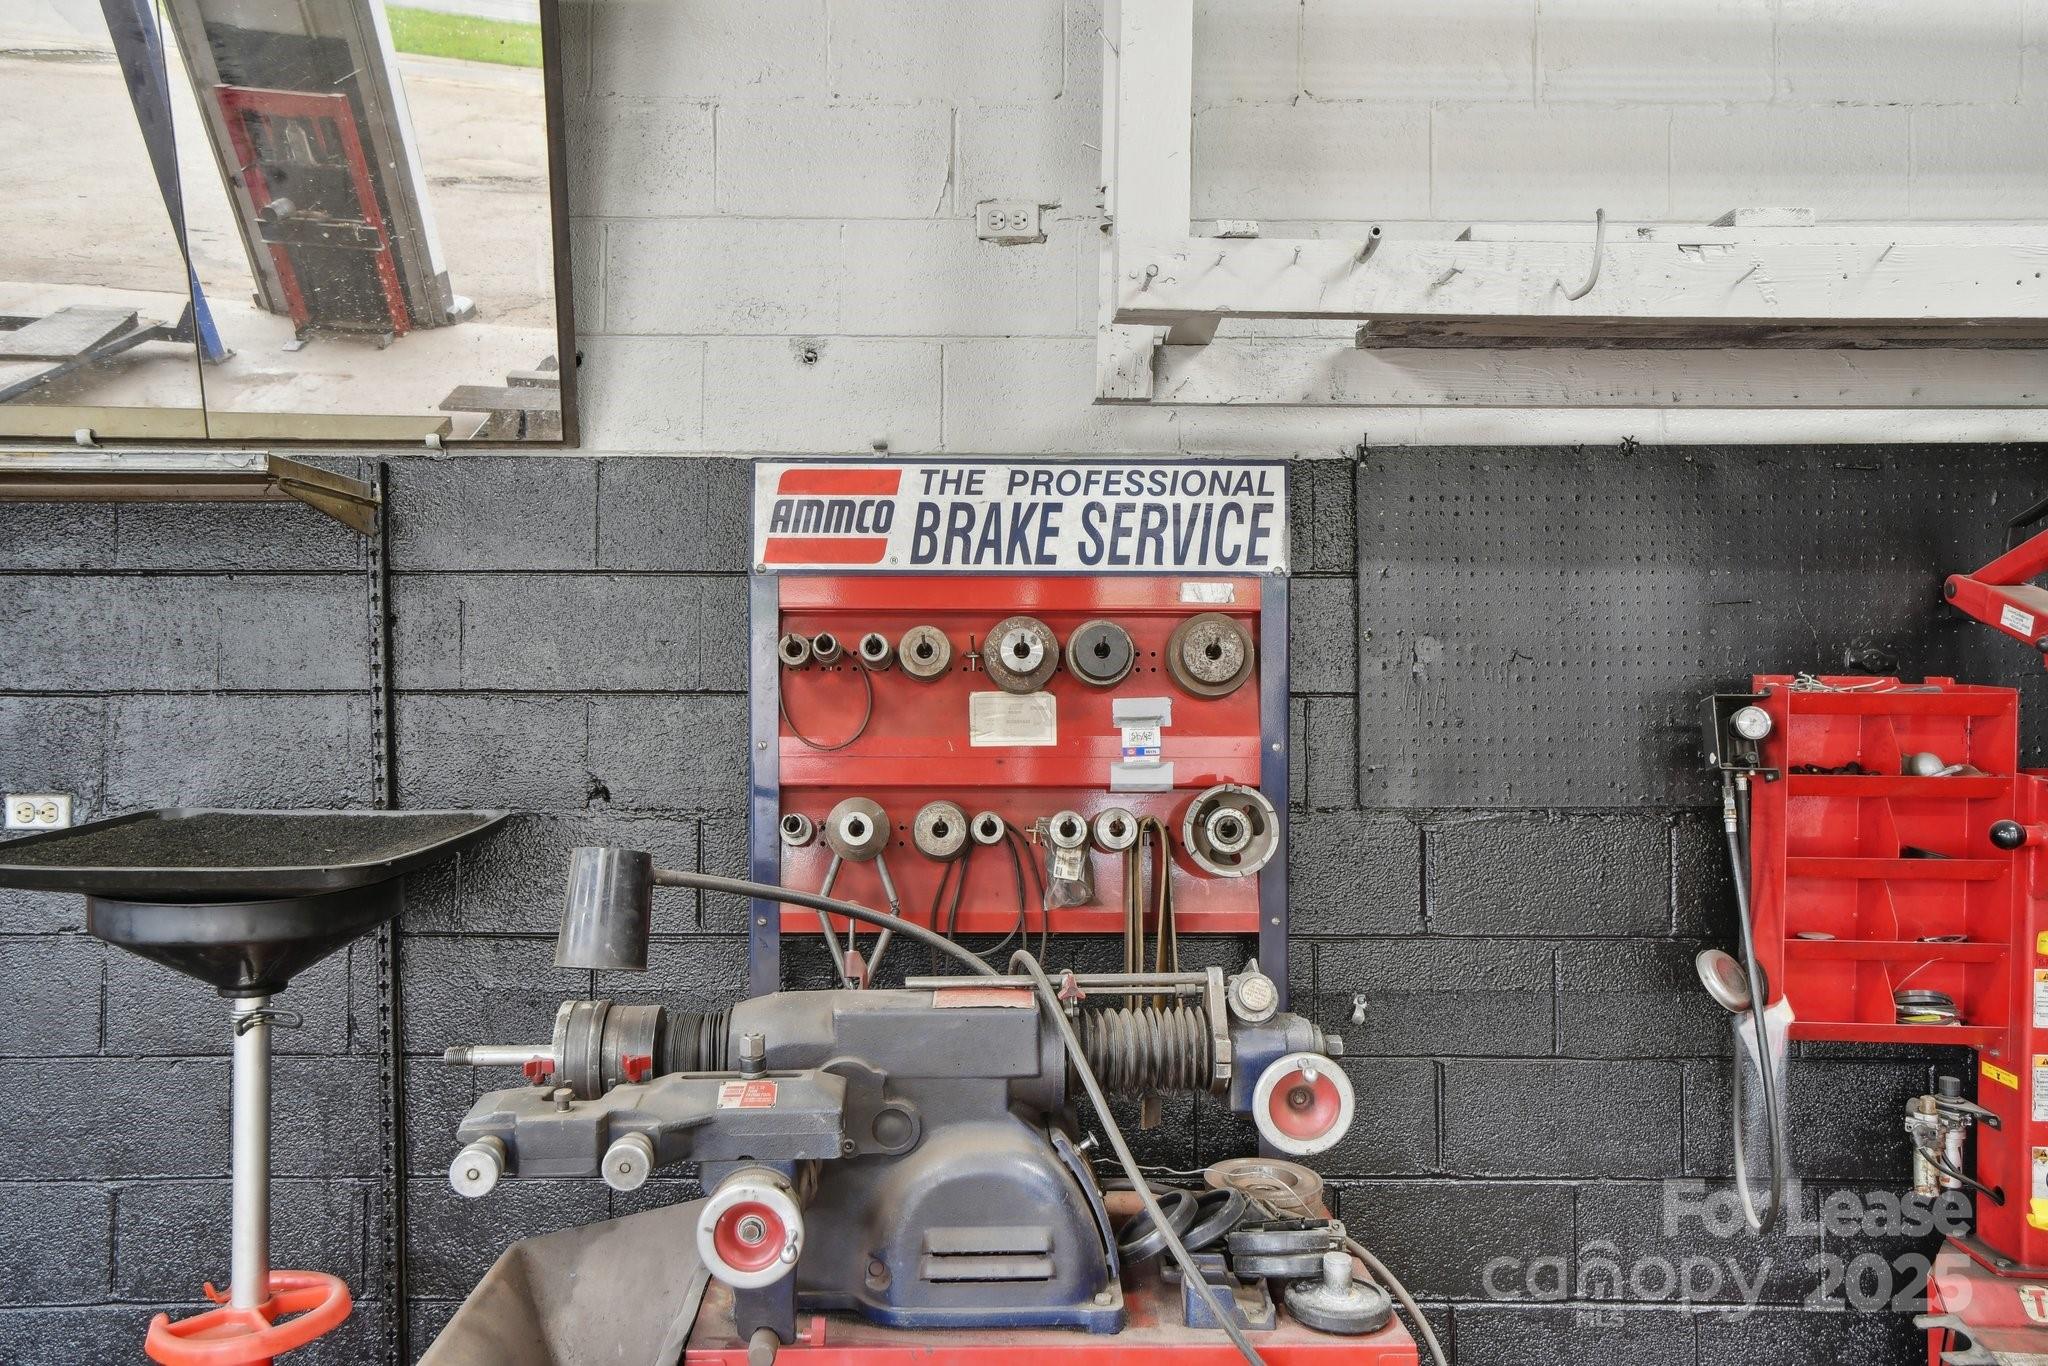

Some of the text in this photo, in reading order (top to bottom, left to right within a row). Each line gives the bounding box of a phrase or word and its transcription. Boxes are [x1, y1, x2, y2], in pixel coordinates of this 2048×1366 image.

[920, 469, 1275, 498] THE PROFESSIONAL
[769, 499, 896, 534] AMMCO
[909, 500, 1275, 567] BRAKE SERVICE
